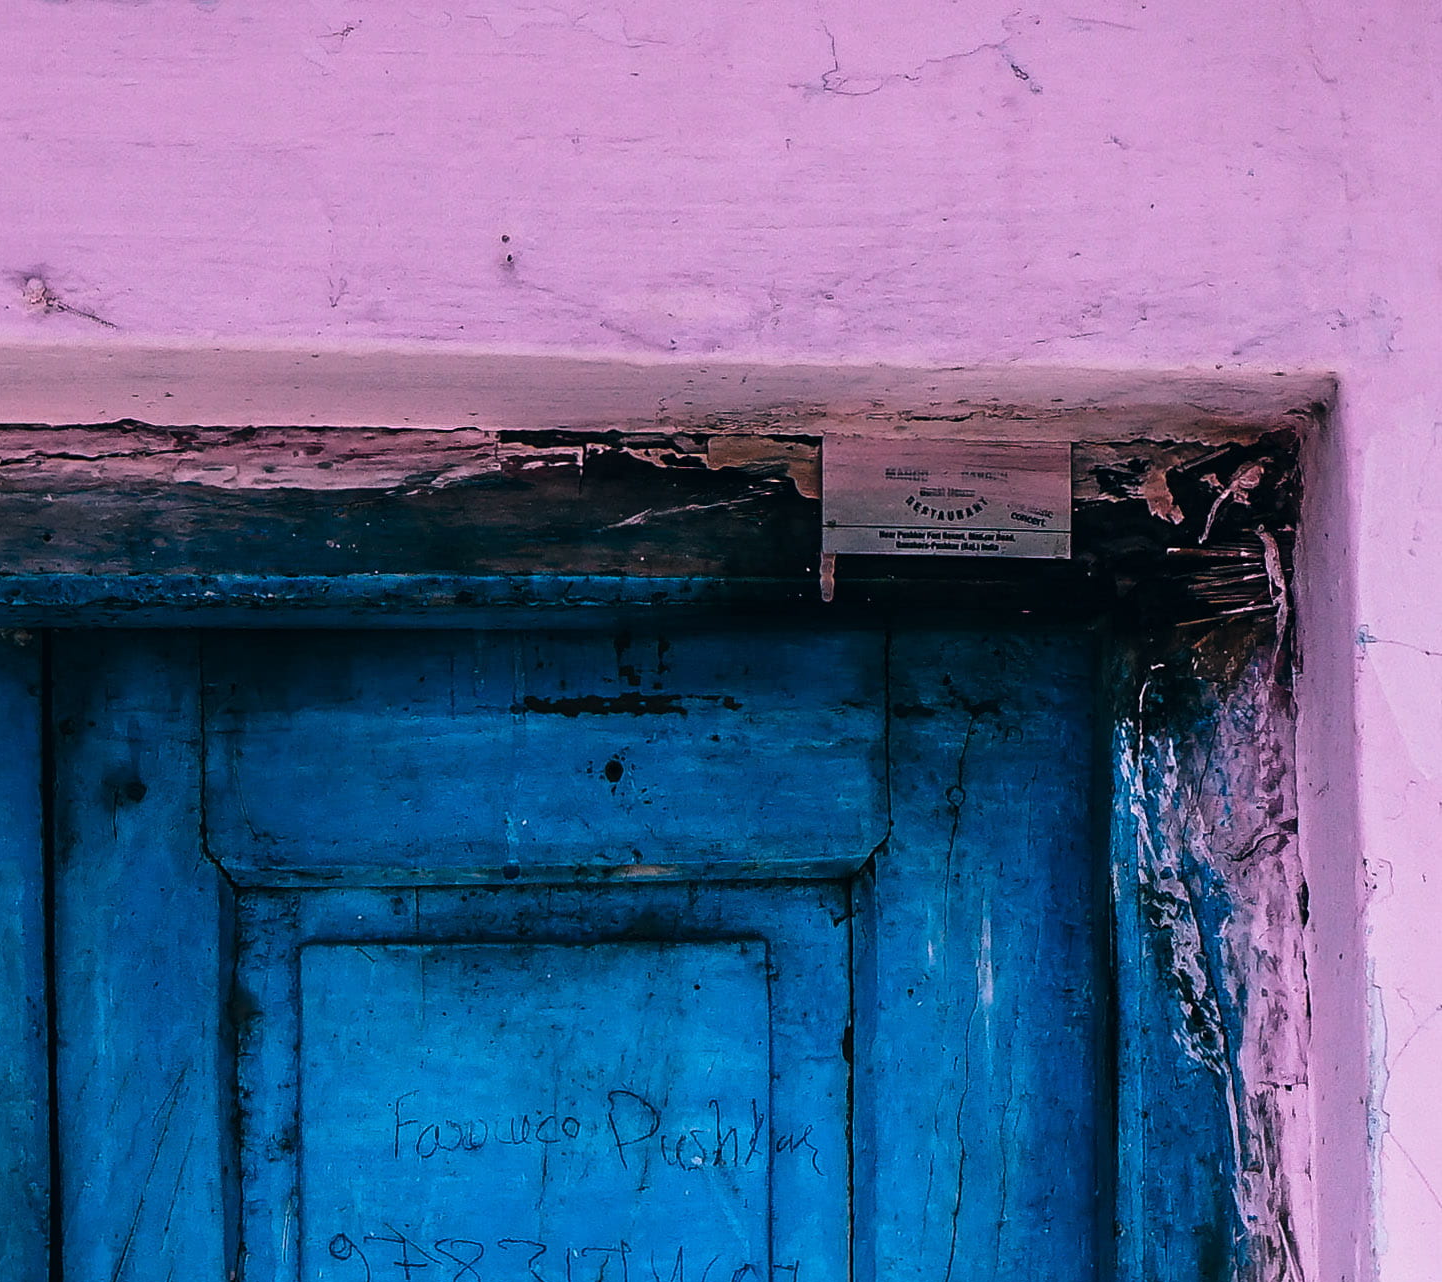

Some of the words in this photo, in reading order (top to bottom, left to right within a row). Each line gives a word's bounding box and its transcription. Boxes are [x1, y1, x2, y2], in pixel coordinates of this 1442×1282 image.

[905, 496, 989, 521] RESTAURANT
[1010, 511, 1047, 527] concert
[879, 530, 896, 539] Near
[897, 530, 925, 540] Pushkar
